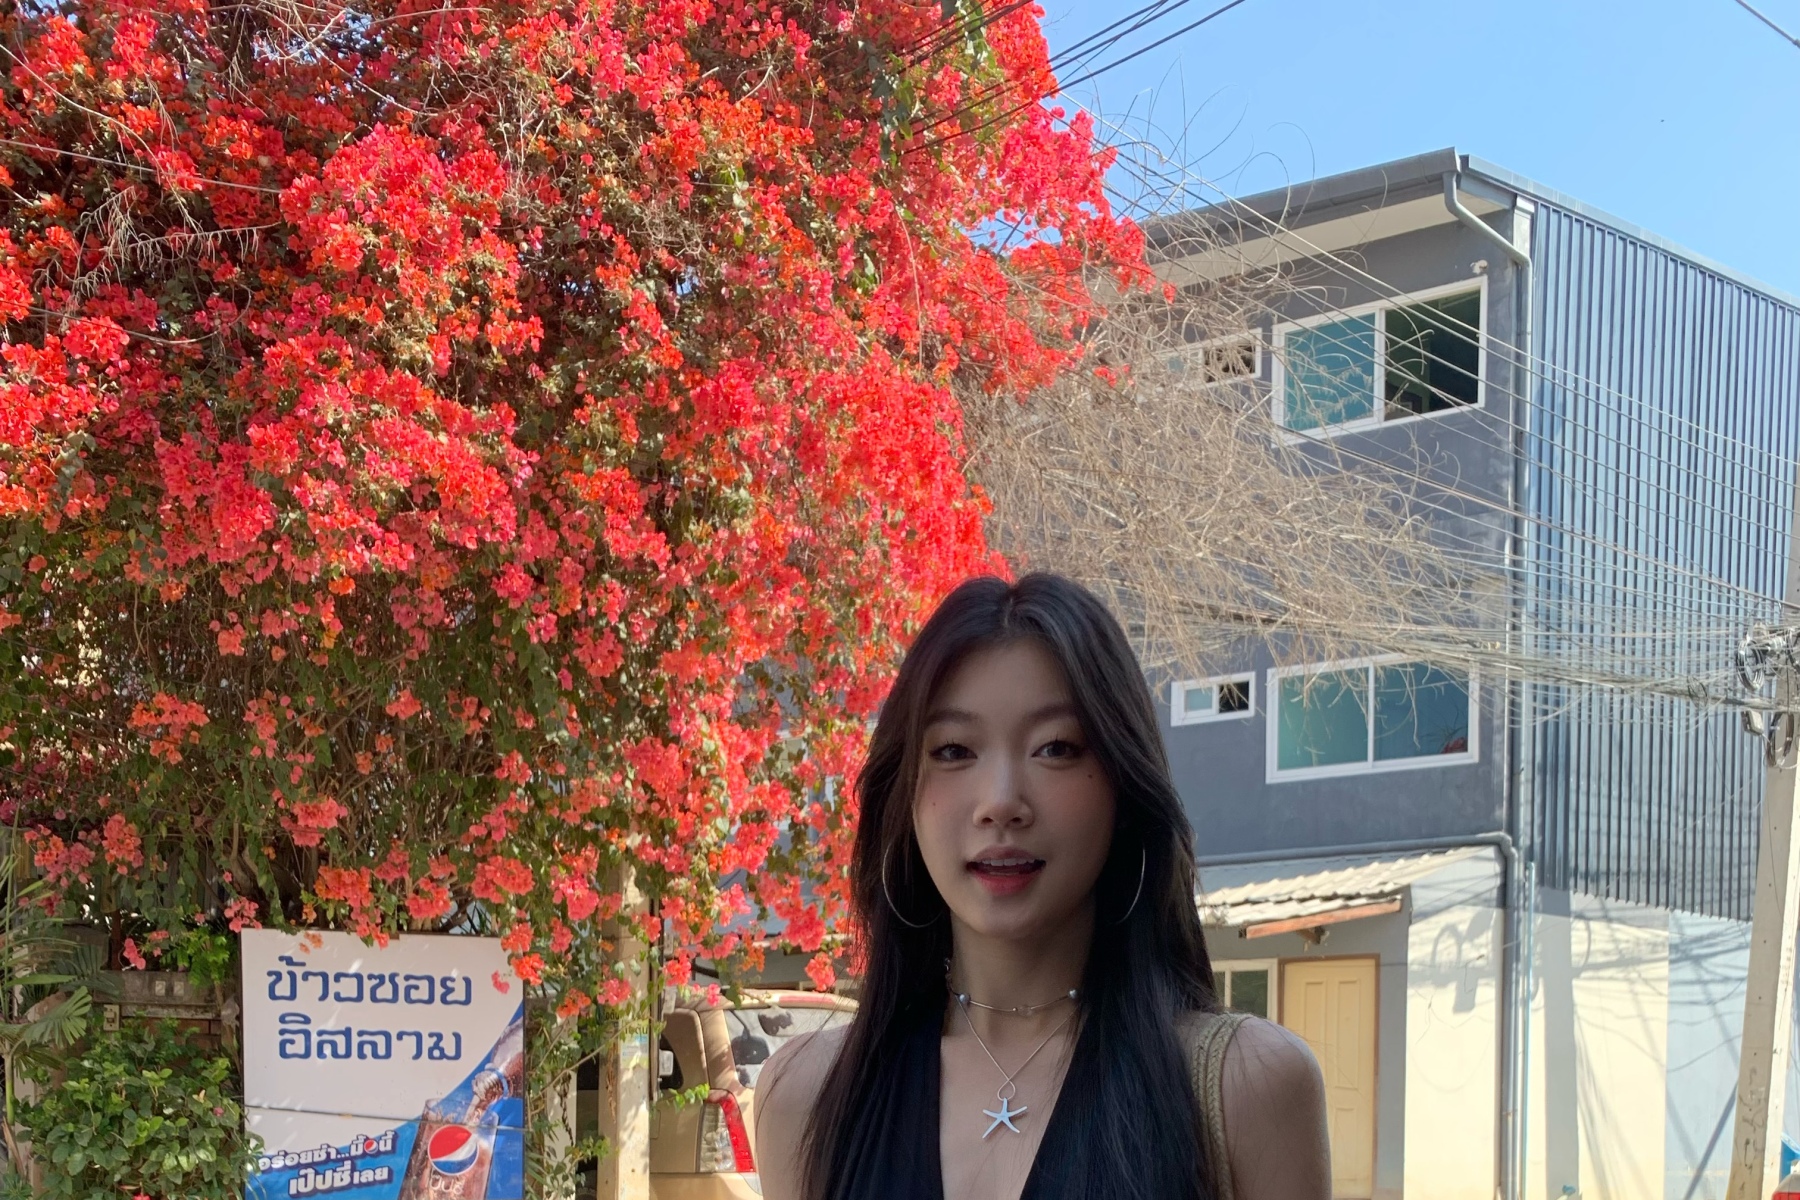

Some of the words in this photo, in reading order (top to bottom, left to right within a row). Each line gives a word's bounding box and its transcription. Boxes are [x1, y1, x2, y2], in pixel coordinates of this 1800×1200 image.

[267, 955, 472, 1006] ข้าวซอย
[278, 1011, 462, 1062] อิสลาม
